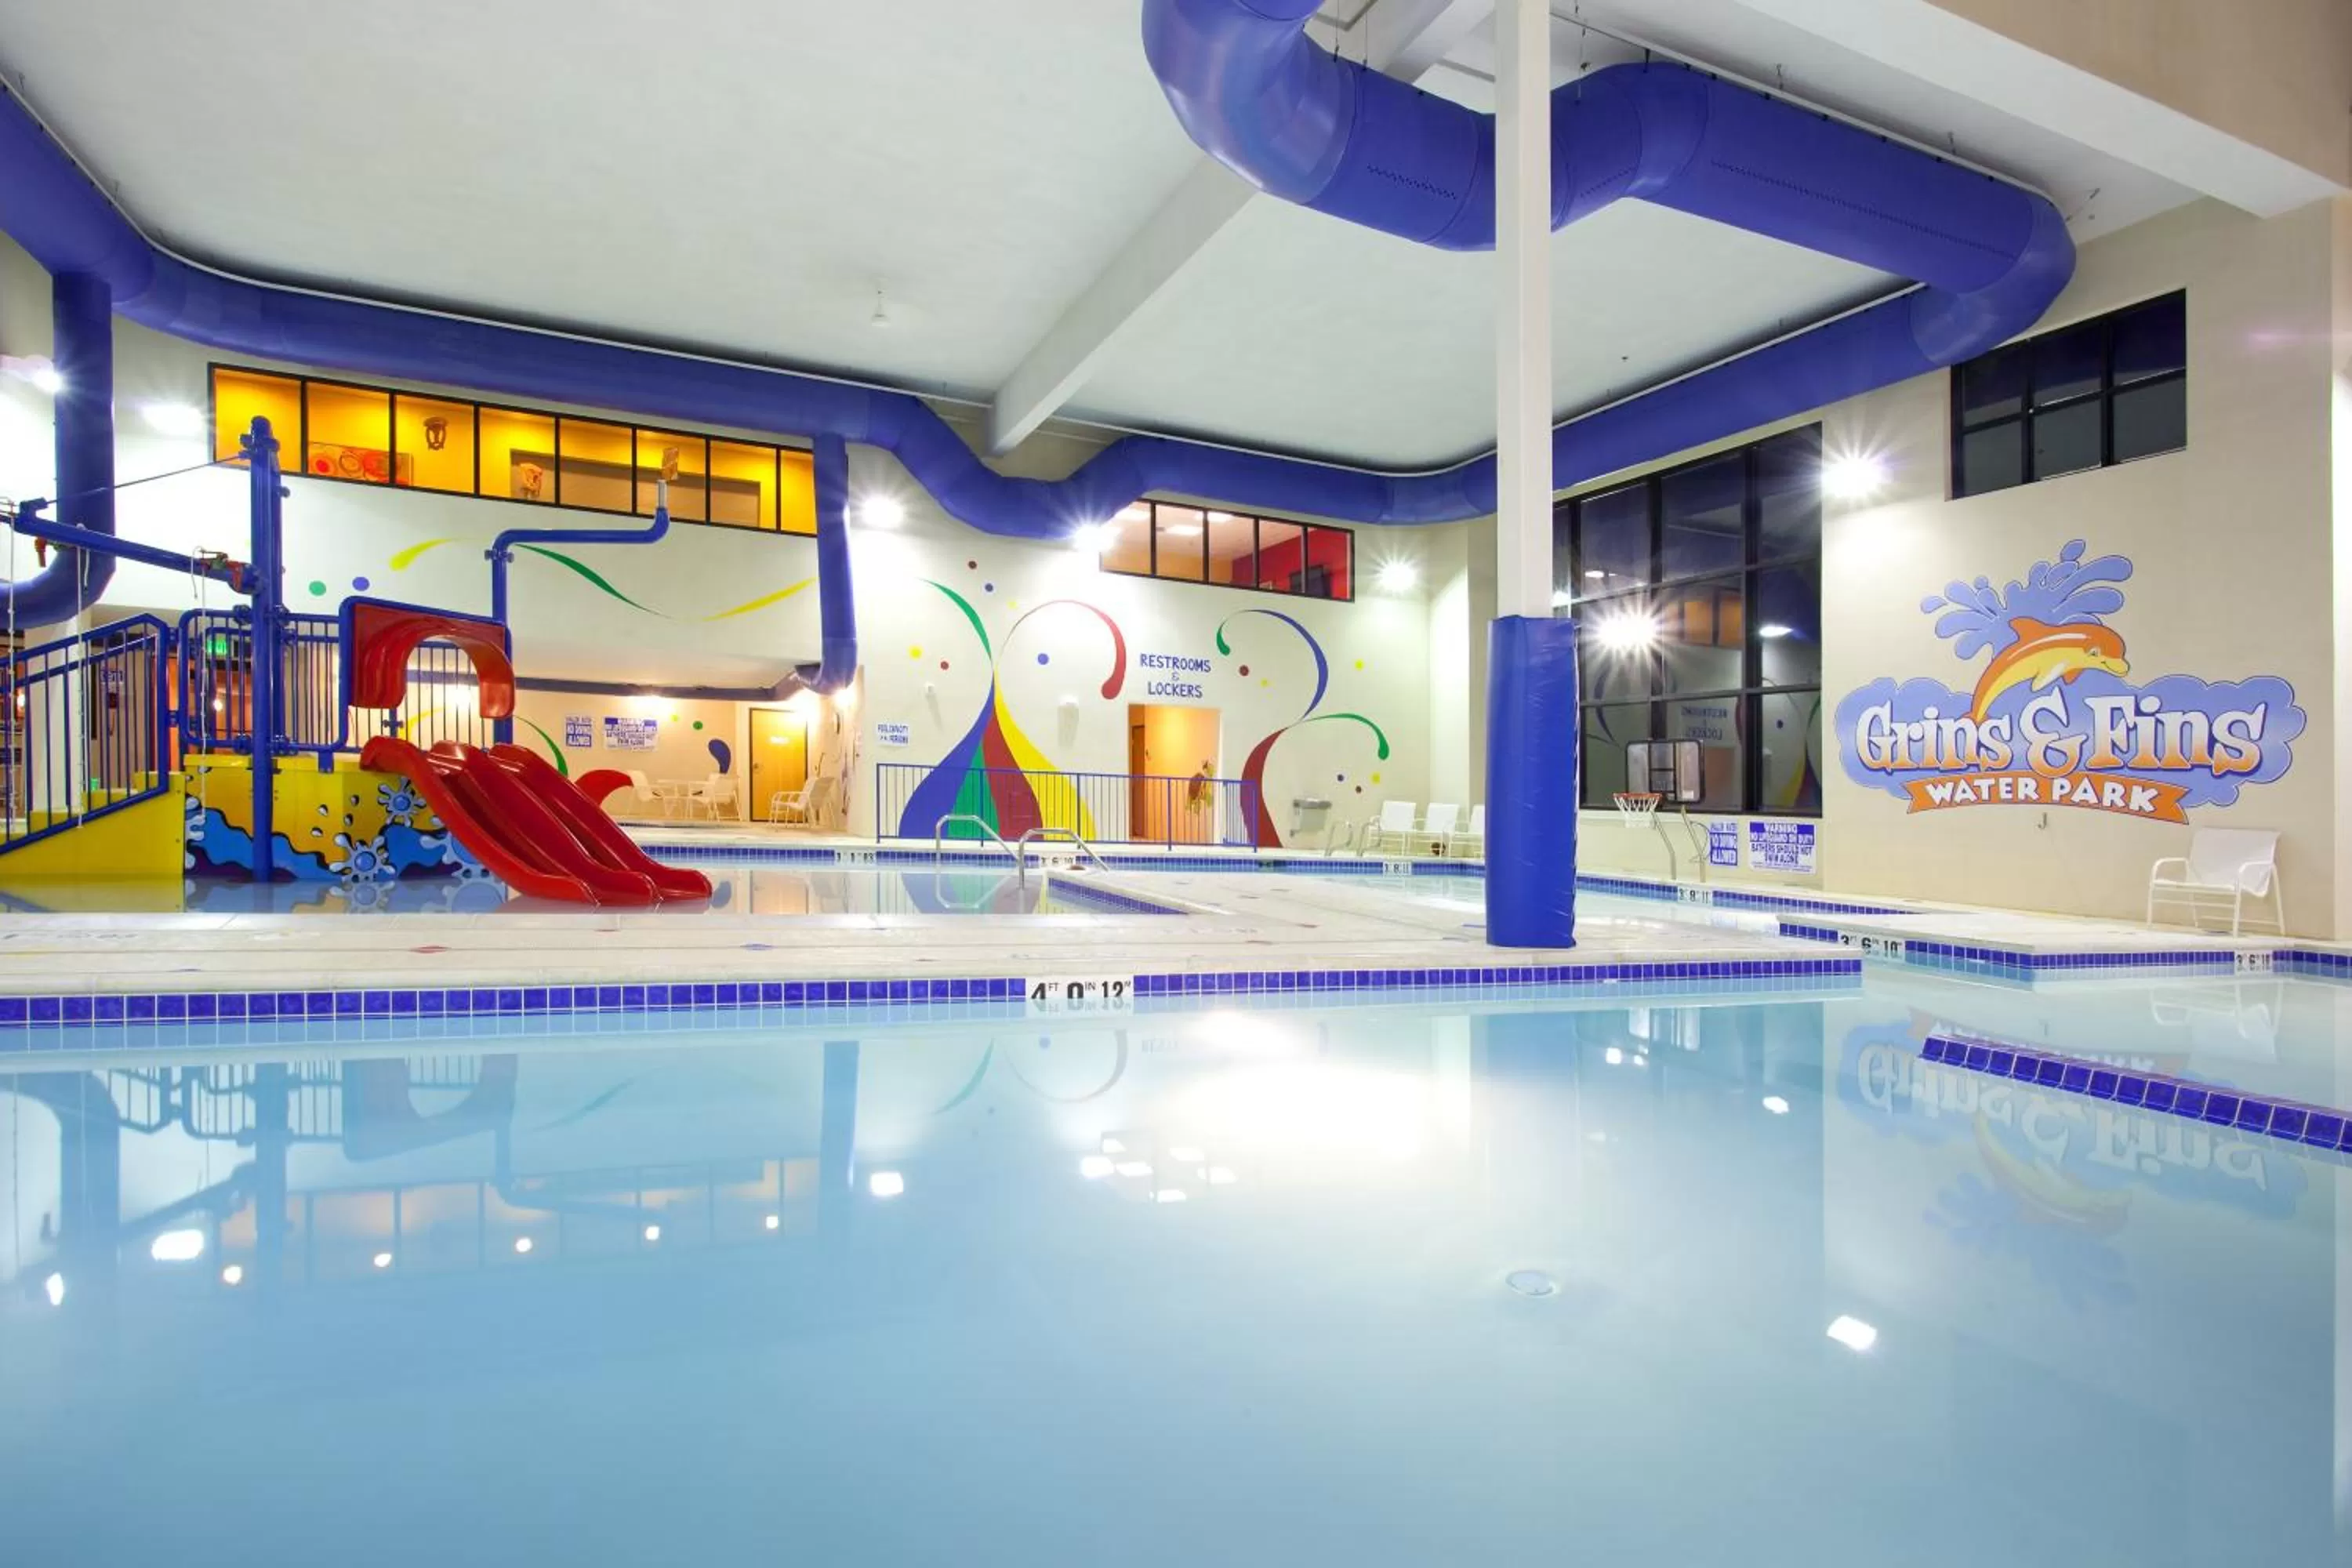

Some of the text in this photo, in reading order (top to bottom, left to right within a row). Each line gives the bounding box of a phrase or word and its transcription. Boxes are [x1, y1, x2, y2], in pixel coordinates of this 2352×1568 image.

[1140, 653, 1211, 673] RESTROOMS
[1148, 681, 1203, 698] LOCKERS
[1856, 684, 2268, 778] Grins & Fins
[1926, 777, 2158, 813] WATER PARK
